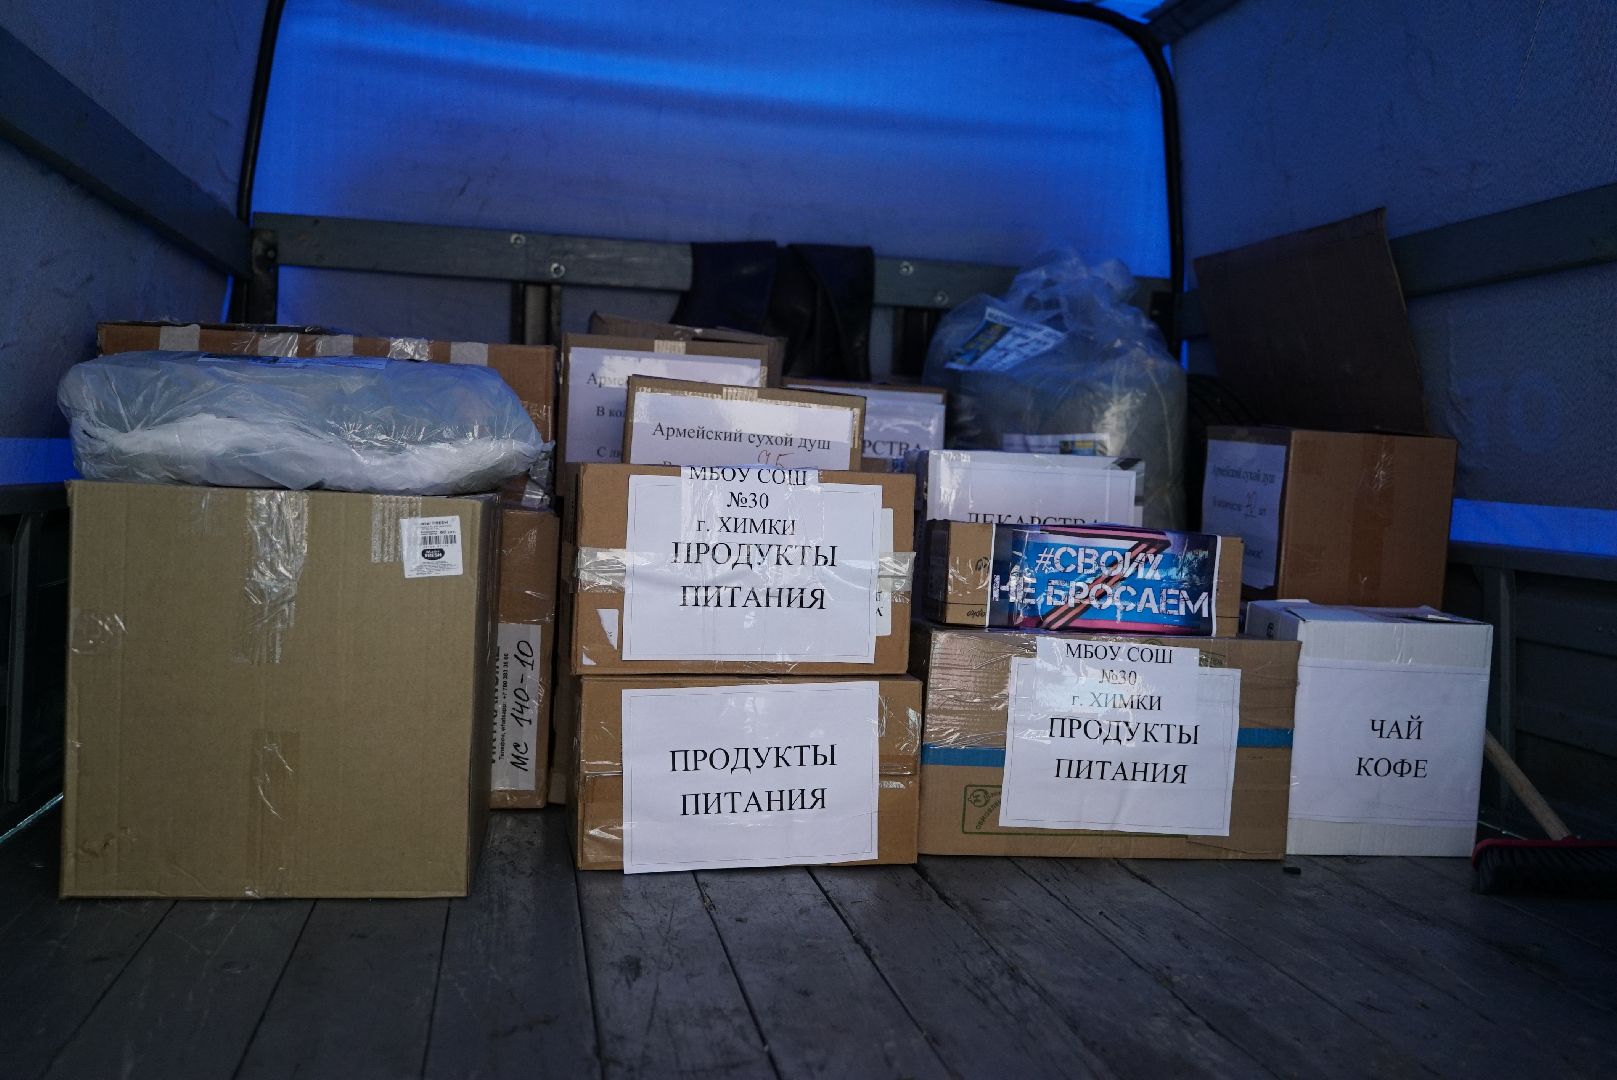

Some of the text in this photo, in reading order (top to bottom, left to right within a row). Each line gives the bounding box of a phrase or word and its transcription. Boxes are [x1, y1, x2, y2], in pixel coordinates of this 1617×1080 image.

[652, 421, 831, 452] Армейский сухой душ
[689, 466, 807, 486] МБОУ СОШ
[727, 491, 769, 509] №30
[697, 517, 796, 536] г. ХИМКИ
[967, 511, 1099, 525] ЛЕКАРСТ
[671, 541, 838, 569] ПРОДУКТЫ
[1034, 546, 1163, 580] #СВОИХ
[679, 585, 827, 610] ПИТАНИЯ
[992, 575, 1209, 618] НЕ БРОСАЕМ
[1065, 643, 1173, 664] МБОУ СОШ
[510, 640, 535, 728] 140-10
[1098, 668, 1137, 686] №30
[1071, 694, 1162, 711] г. ХИМКИ
[1049, 716, 1200, 746] ПРОДУКТЫ
[1370, 715, 1424, 740] ЧАЙ
[669, 743, 837, 775] ПРОДУКТЫ
[1054, 758, 1189, 785] ПИТАНИЯ
[1355, 757, 1428, 778] КОФЕ
[680, 787, 827, 816] ПИТАНИЯ
